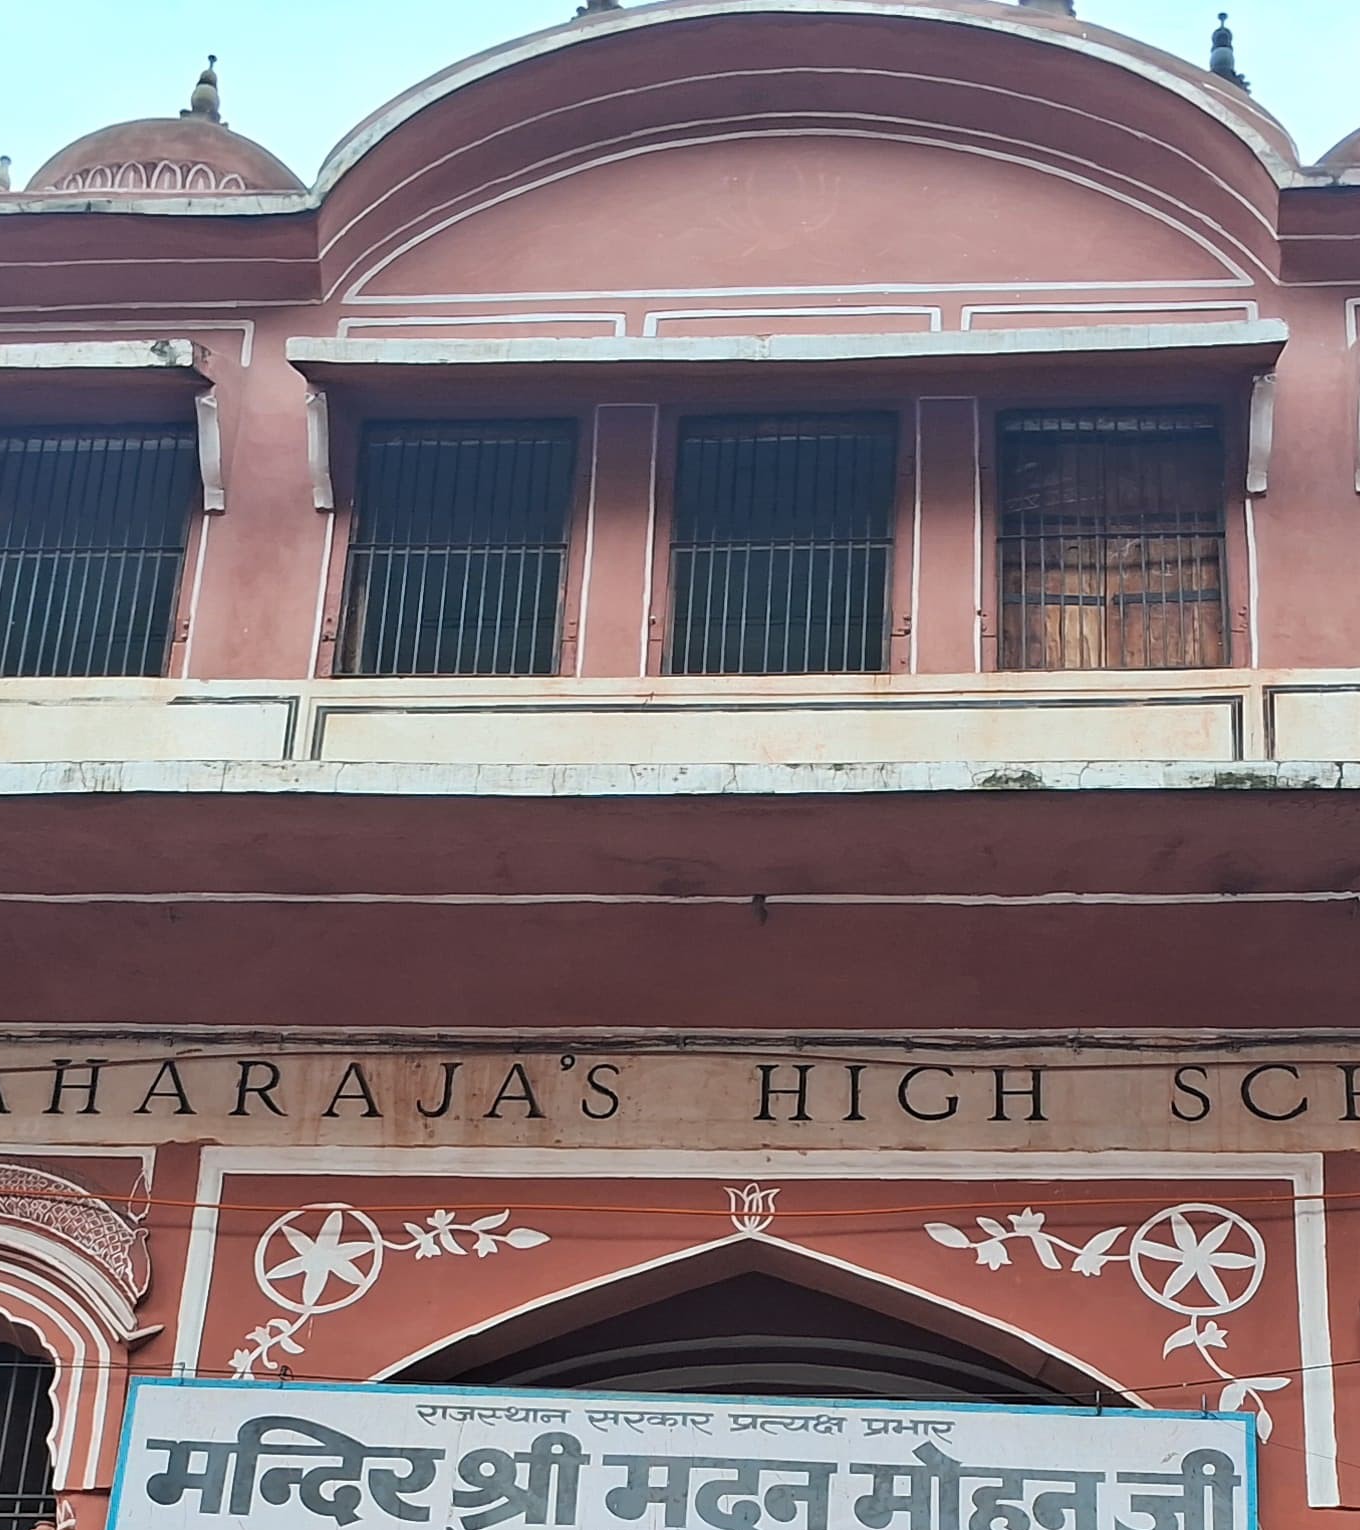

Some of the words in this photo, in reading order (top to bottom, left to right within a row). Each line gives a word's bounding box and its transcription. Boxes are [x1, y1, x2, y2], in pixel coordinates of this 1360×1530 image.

[753, 1064, 1048, 1122] HIGH
[416, 1404, 571, 1427] राजस्थान
[585, 1409, 714, 1435] सरकार
[728, 1413, 847, 1436] प्रत्यक्ष
[861, 1418, 955, 1445] प्रभार
[146, 1415, 445, 1527] मन्दिर
